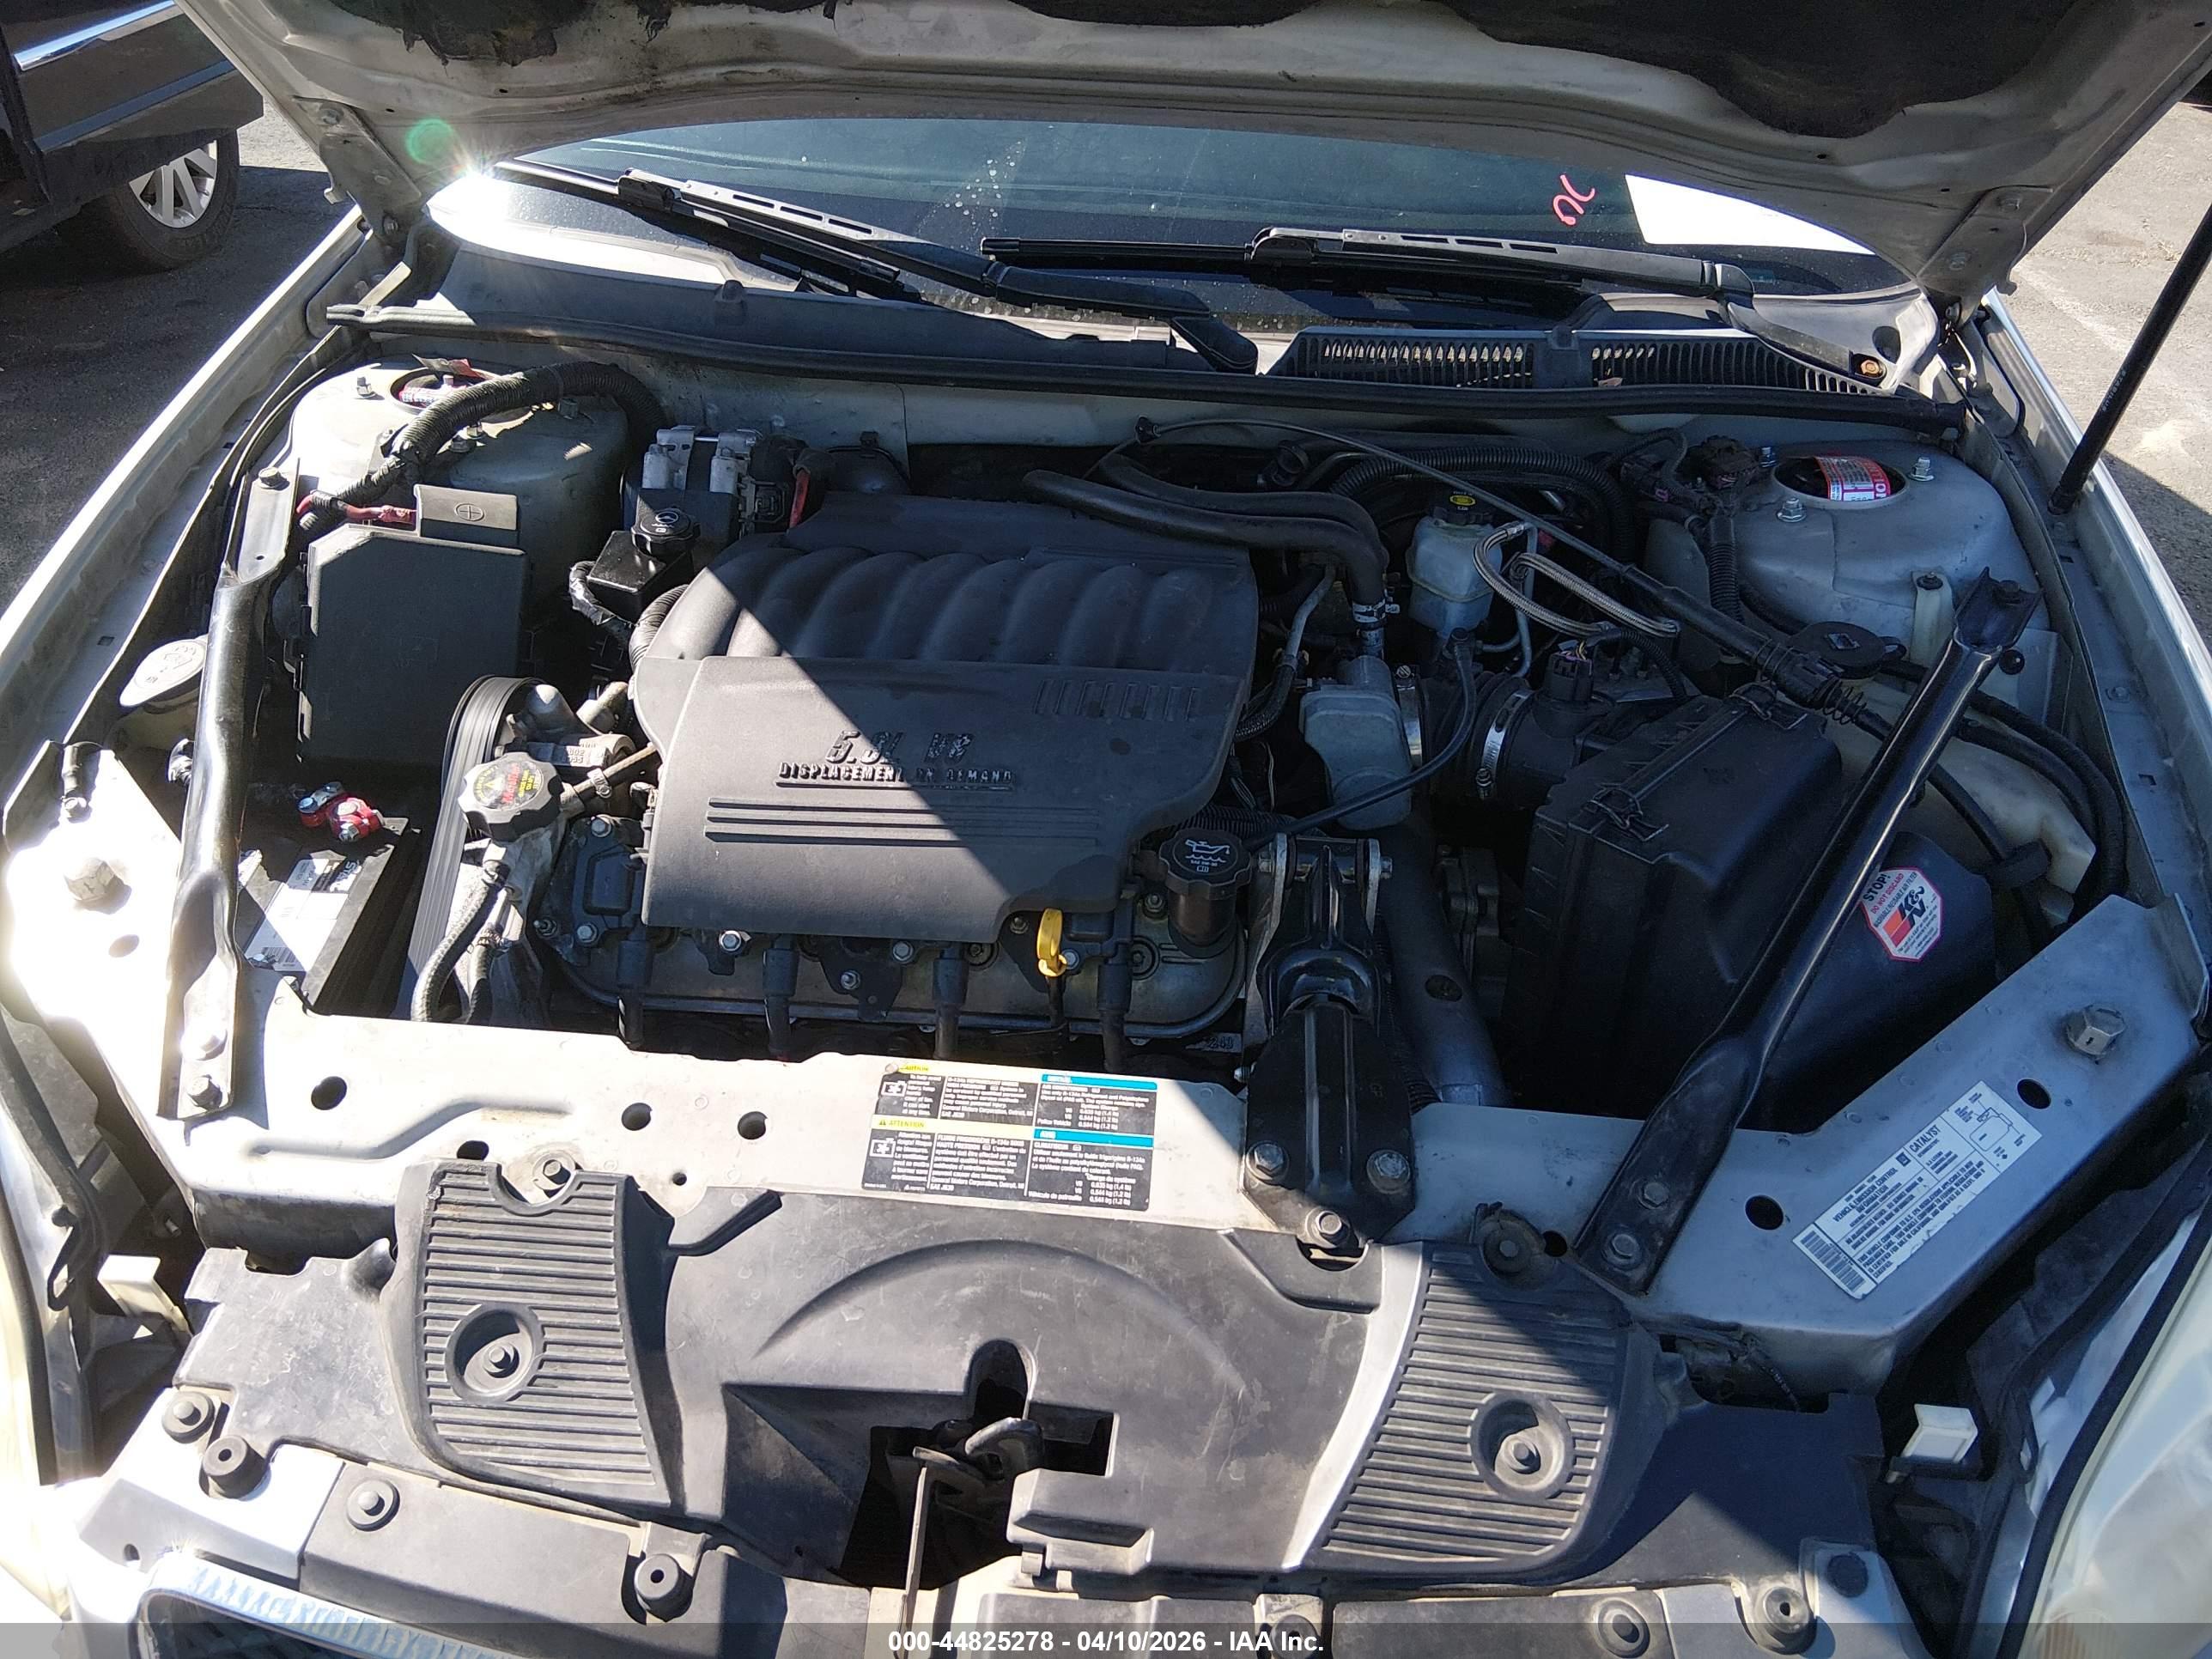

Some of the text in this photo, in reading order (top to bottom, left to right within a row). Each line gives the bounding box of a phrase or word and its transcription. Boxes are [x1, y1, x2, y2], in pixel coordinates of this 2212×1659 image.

[825, 730, 974, 765] 5.3L V8
[779, 762, 1012, 784] DISPLACEMENT ON DEMAND
[1863, 874, 1891, 901] STOP!
[1870, 872, 1904, 914] DO NOT DISCARD
[1908, 1125, 1941, 1152] CATALYST
